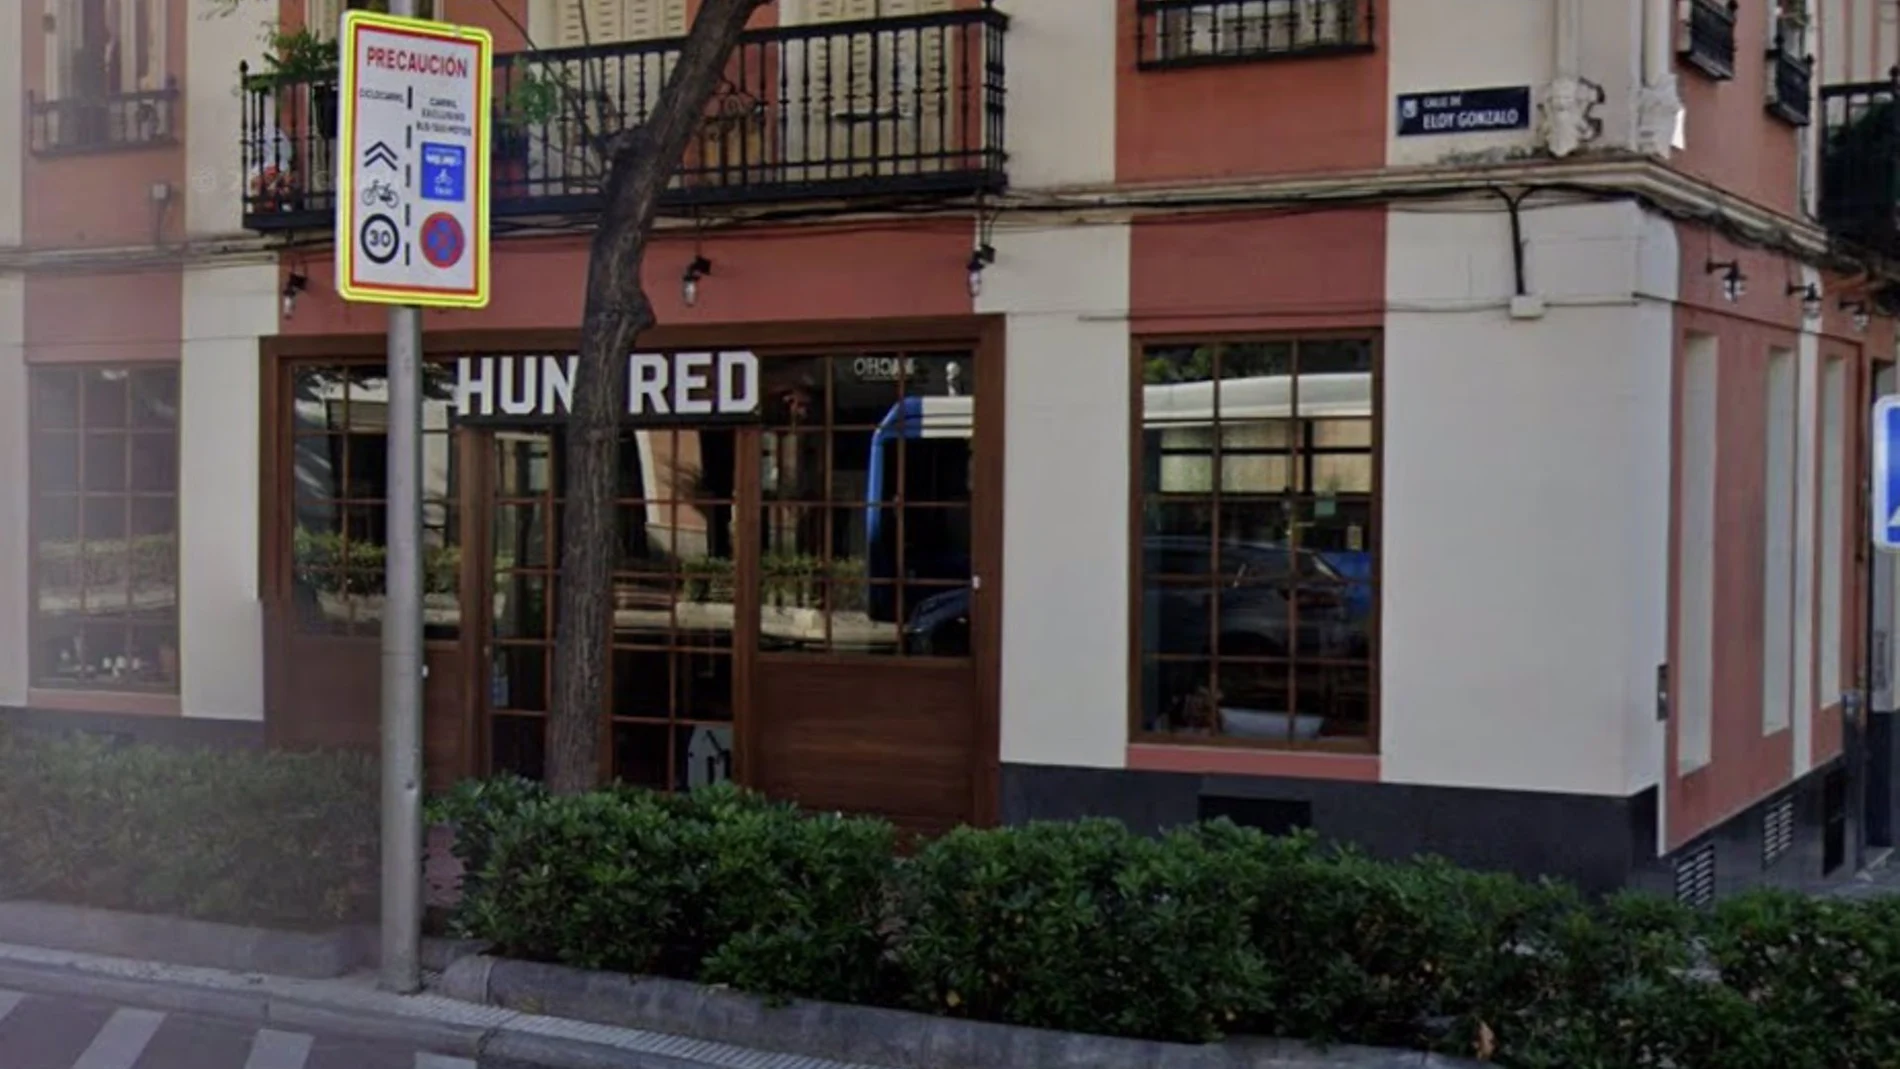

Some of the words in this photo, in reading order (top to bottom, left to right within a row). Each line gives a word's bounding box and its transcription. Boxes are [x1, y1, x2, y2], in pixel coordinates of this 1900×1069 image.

[367, 46, 468, 79] PRECAUCIÓN
[1422, 96, 1448, 109] CALLE
[1449, 95, 1461, 107] DE
[1422, 112, 1455, 130] ELOY
[1457, 108, 1519, 128] GONZALO
[369, 228, 391, 248] 30
[457, 351, 759, 416] HUNRED
